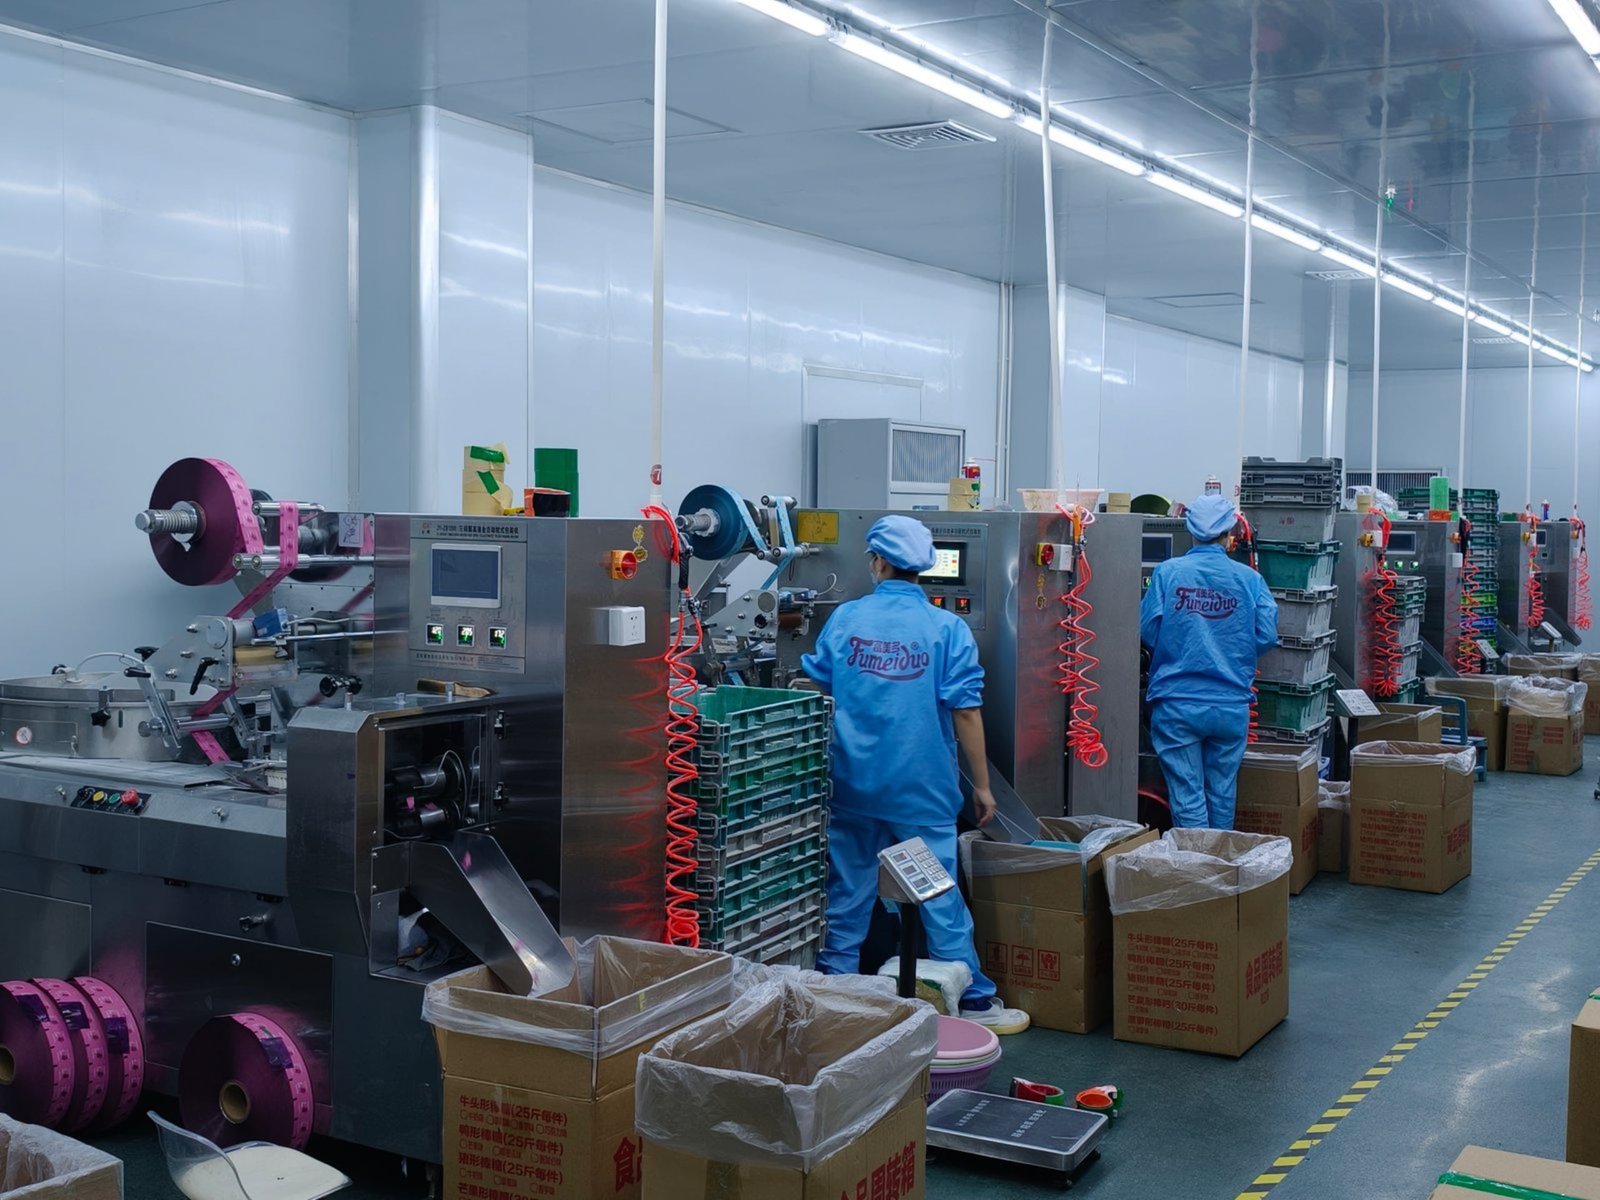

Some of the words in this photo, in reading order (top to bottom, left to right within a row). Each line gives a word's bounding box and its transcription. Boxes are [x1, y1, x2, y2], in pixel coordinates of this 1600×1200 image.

[847, 636, 930, 671] Fumeiduo
[873, 640, 900, 653] 富美多
[613, 1135, 643, 1192] 食
